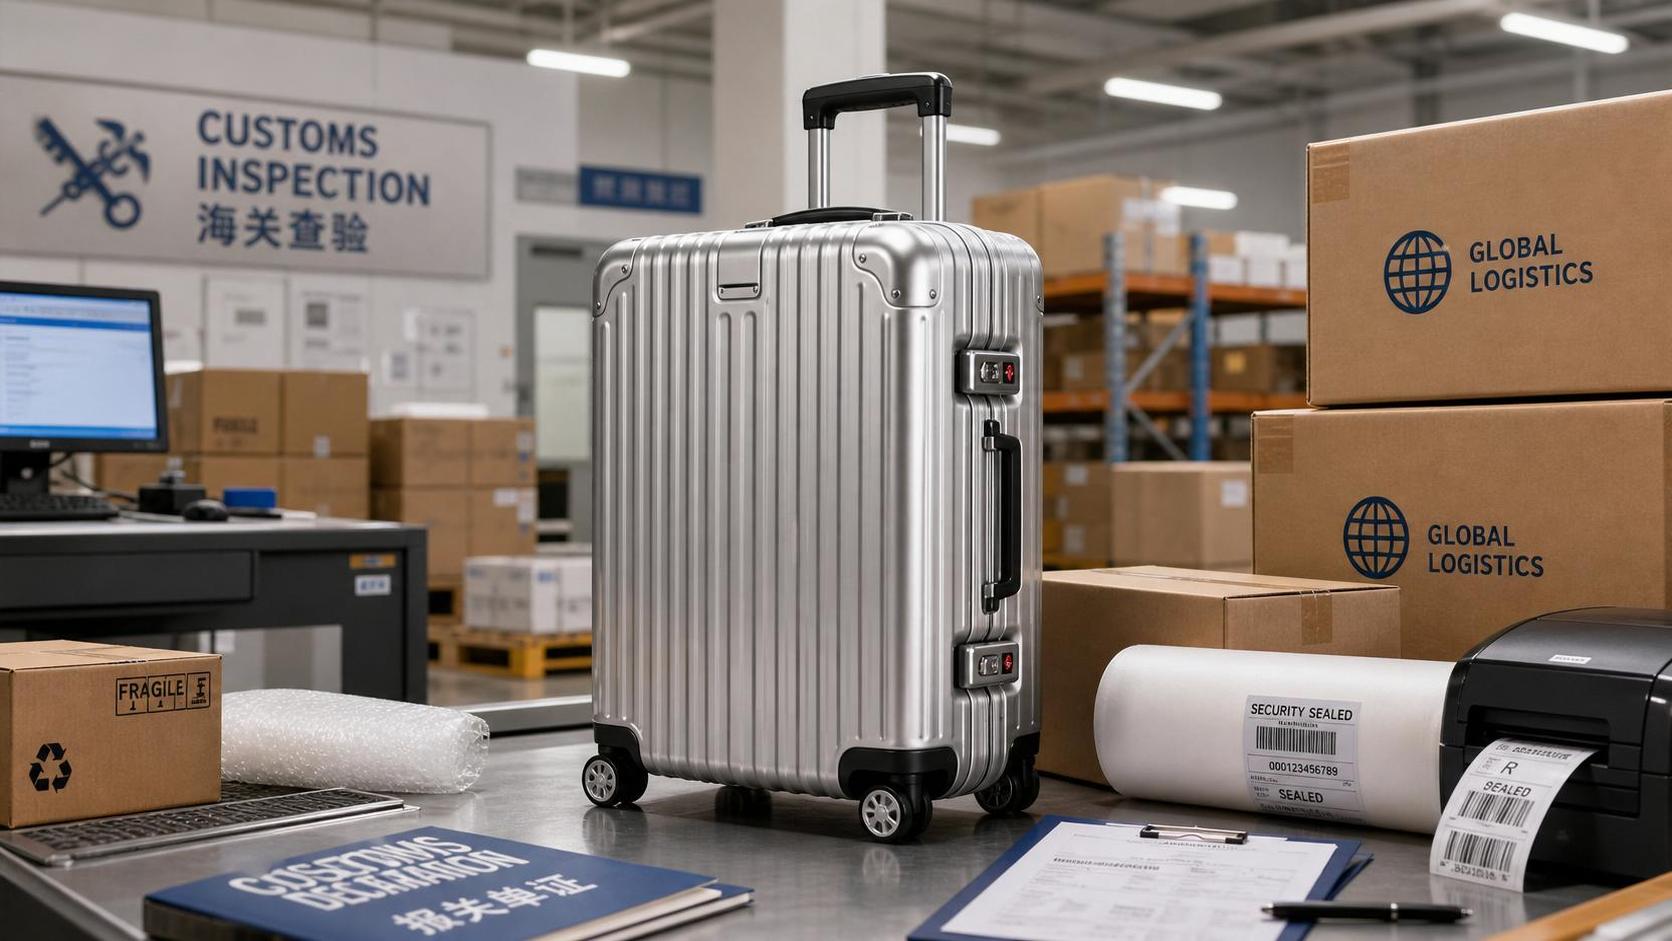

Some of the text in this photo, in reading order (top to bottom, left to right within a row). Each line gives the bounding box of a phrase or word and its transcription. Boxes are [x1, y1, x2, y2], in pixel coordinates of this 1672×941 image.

[198, 110, 378, 158] CUSTOMS
[198, 156, 431, 206] INSPECTION
[197, 203, 369, 254] 海关查验
[1469, 233, 1563, 263] GLOBAL
[1470, 261, 1594, 293] LOGISTICS
[1427, 524, 1515, 547] GLOBAL
[1428, 552, 1544, 578] LOGISTICS
[119, 679, 184, 700] FRAGILE
[1251, 703, 1353, 721] SECURITY SEALED
[1269, 761, 1338, 776] 000123456789
[1500, 761, 1518, 775] R
[1279, 788, 1324, 803] SEALED
[392, 873, 598, 936] 报关单证
